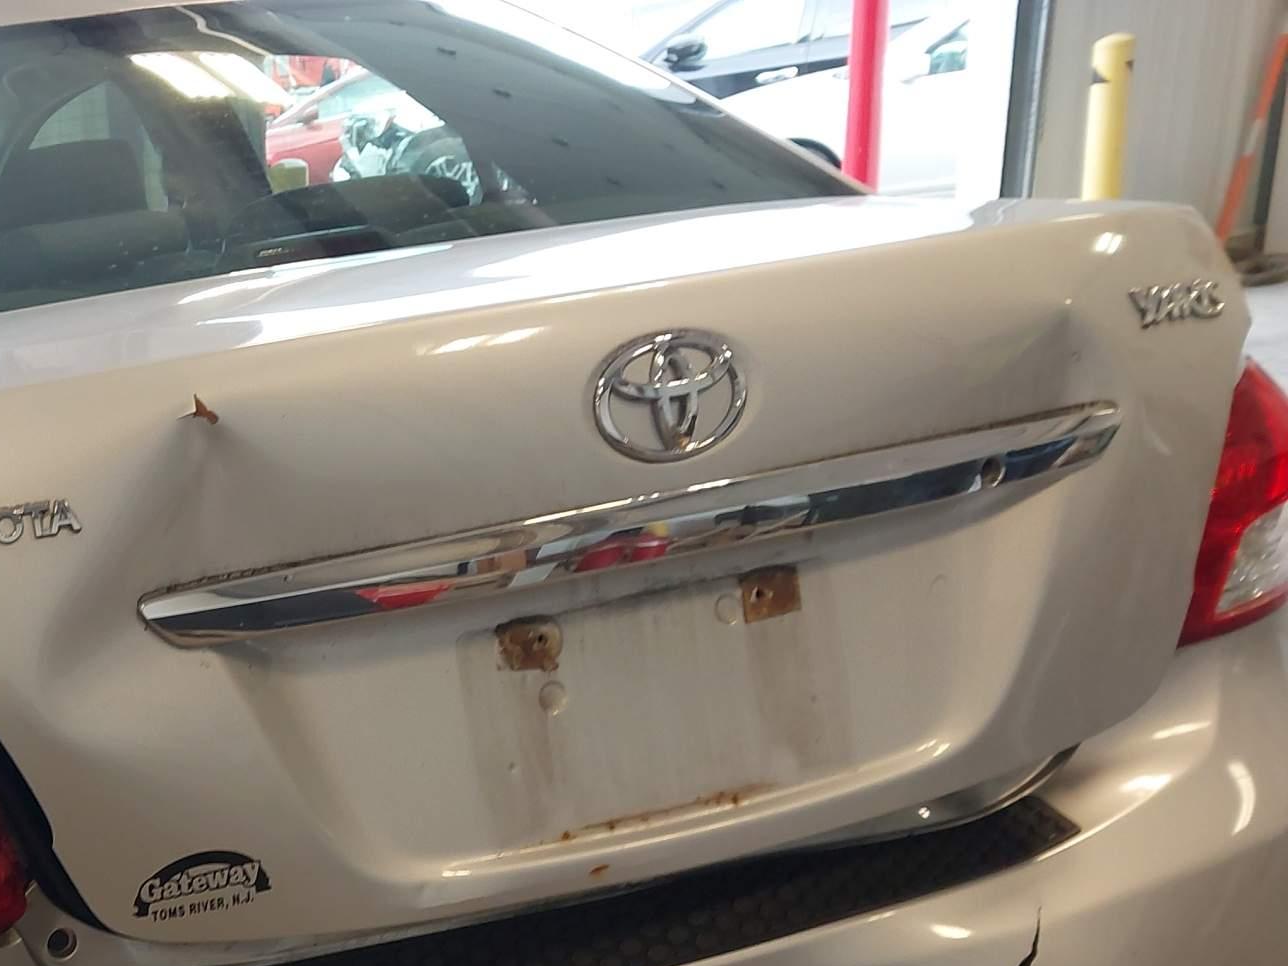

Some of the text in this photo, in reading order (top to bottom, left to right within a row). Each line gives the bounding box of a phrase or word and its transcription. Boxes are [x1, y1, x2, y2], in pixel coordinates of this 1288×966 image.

[139, 860, 261, 904] Gateway
[151, 907, 186, 922] TOMS
[189, 897, 229, 916] RIVER,
